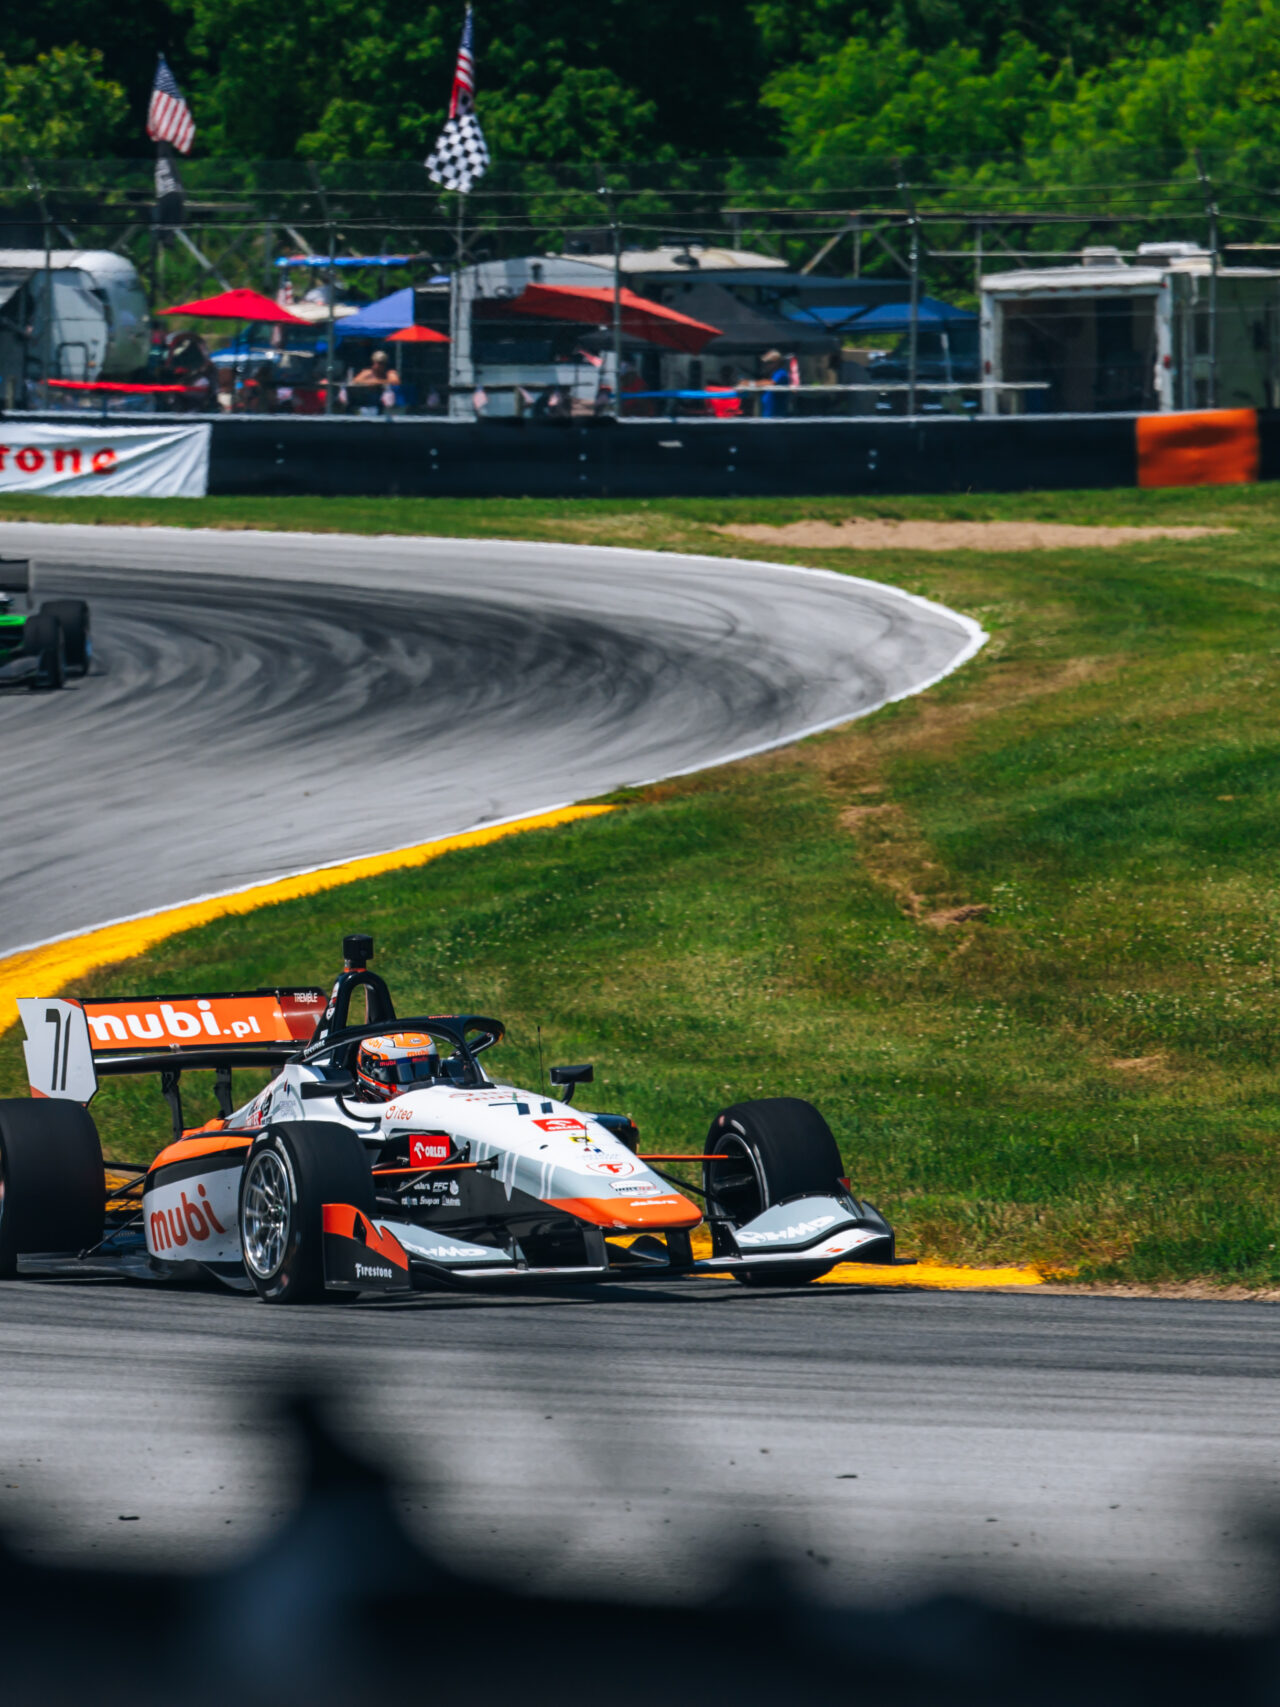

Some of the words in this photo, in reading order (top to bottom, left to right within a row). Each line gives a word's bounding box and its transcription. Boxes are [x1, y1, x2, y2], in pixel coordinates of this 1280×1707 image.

[86, 1000, 261, 1041] mubi.pl
[44, 1008, 72, 1092] 71
[425, 1146, 447, 1158] ORLEN
[150, 1183, 227, 1252] mubi
[354, 1262, 393, 1279] Firestone
